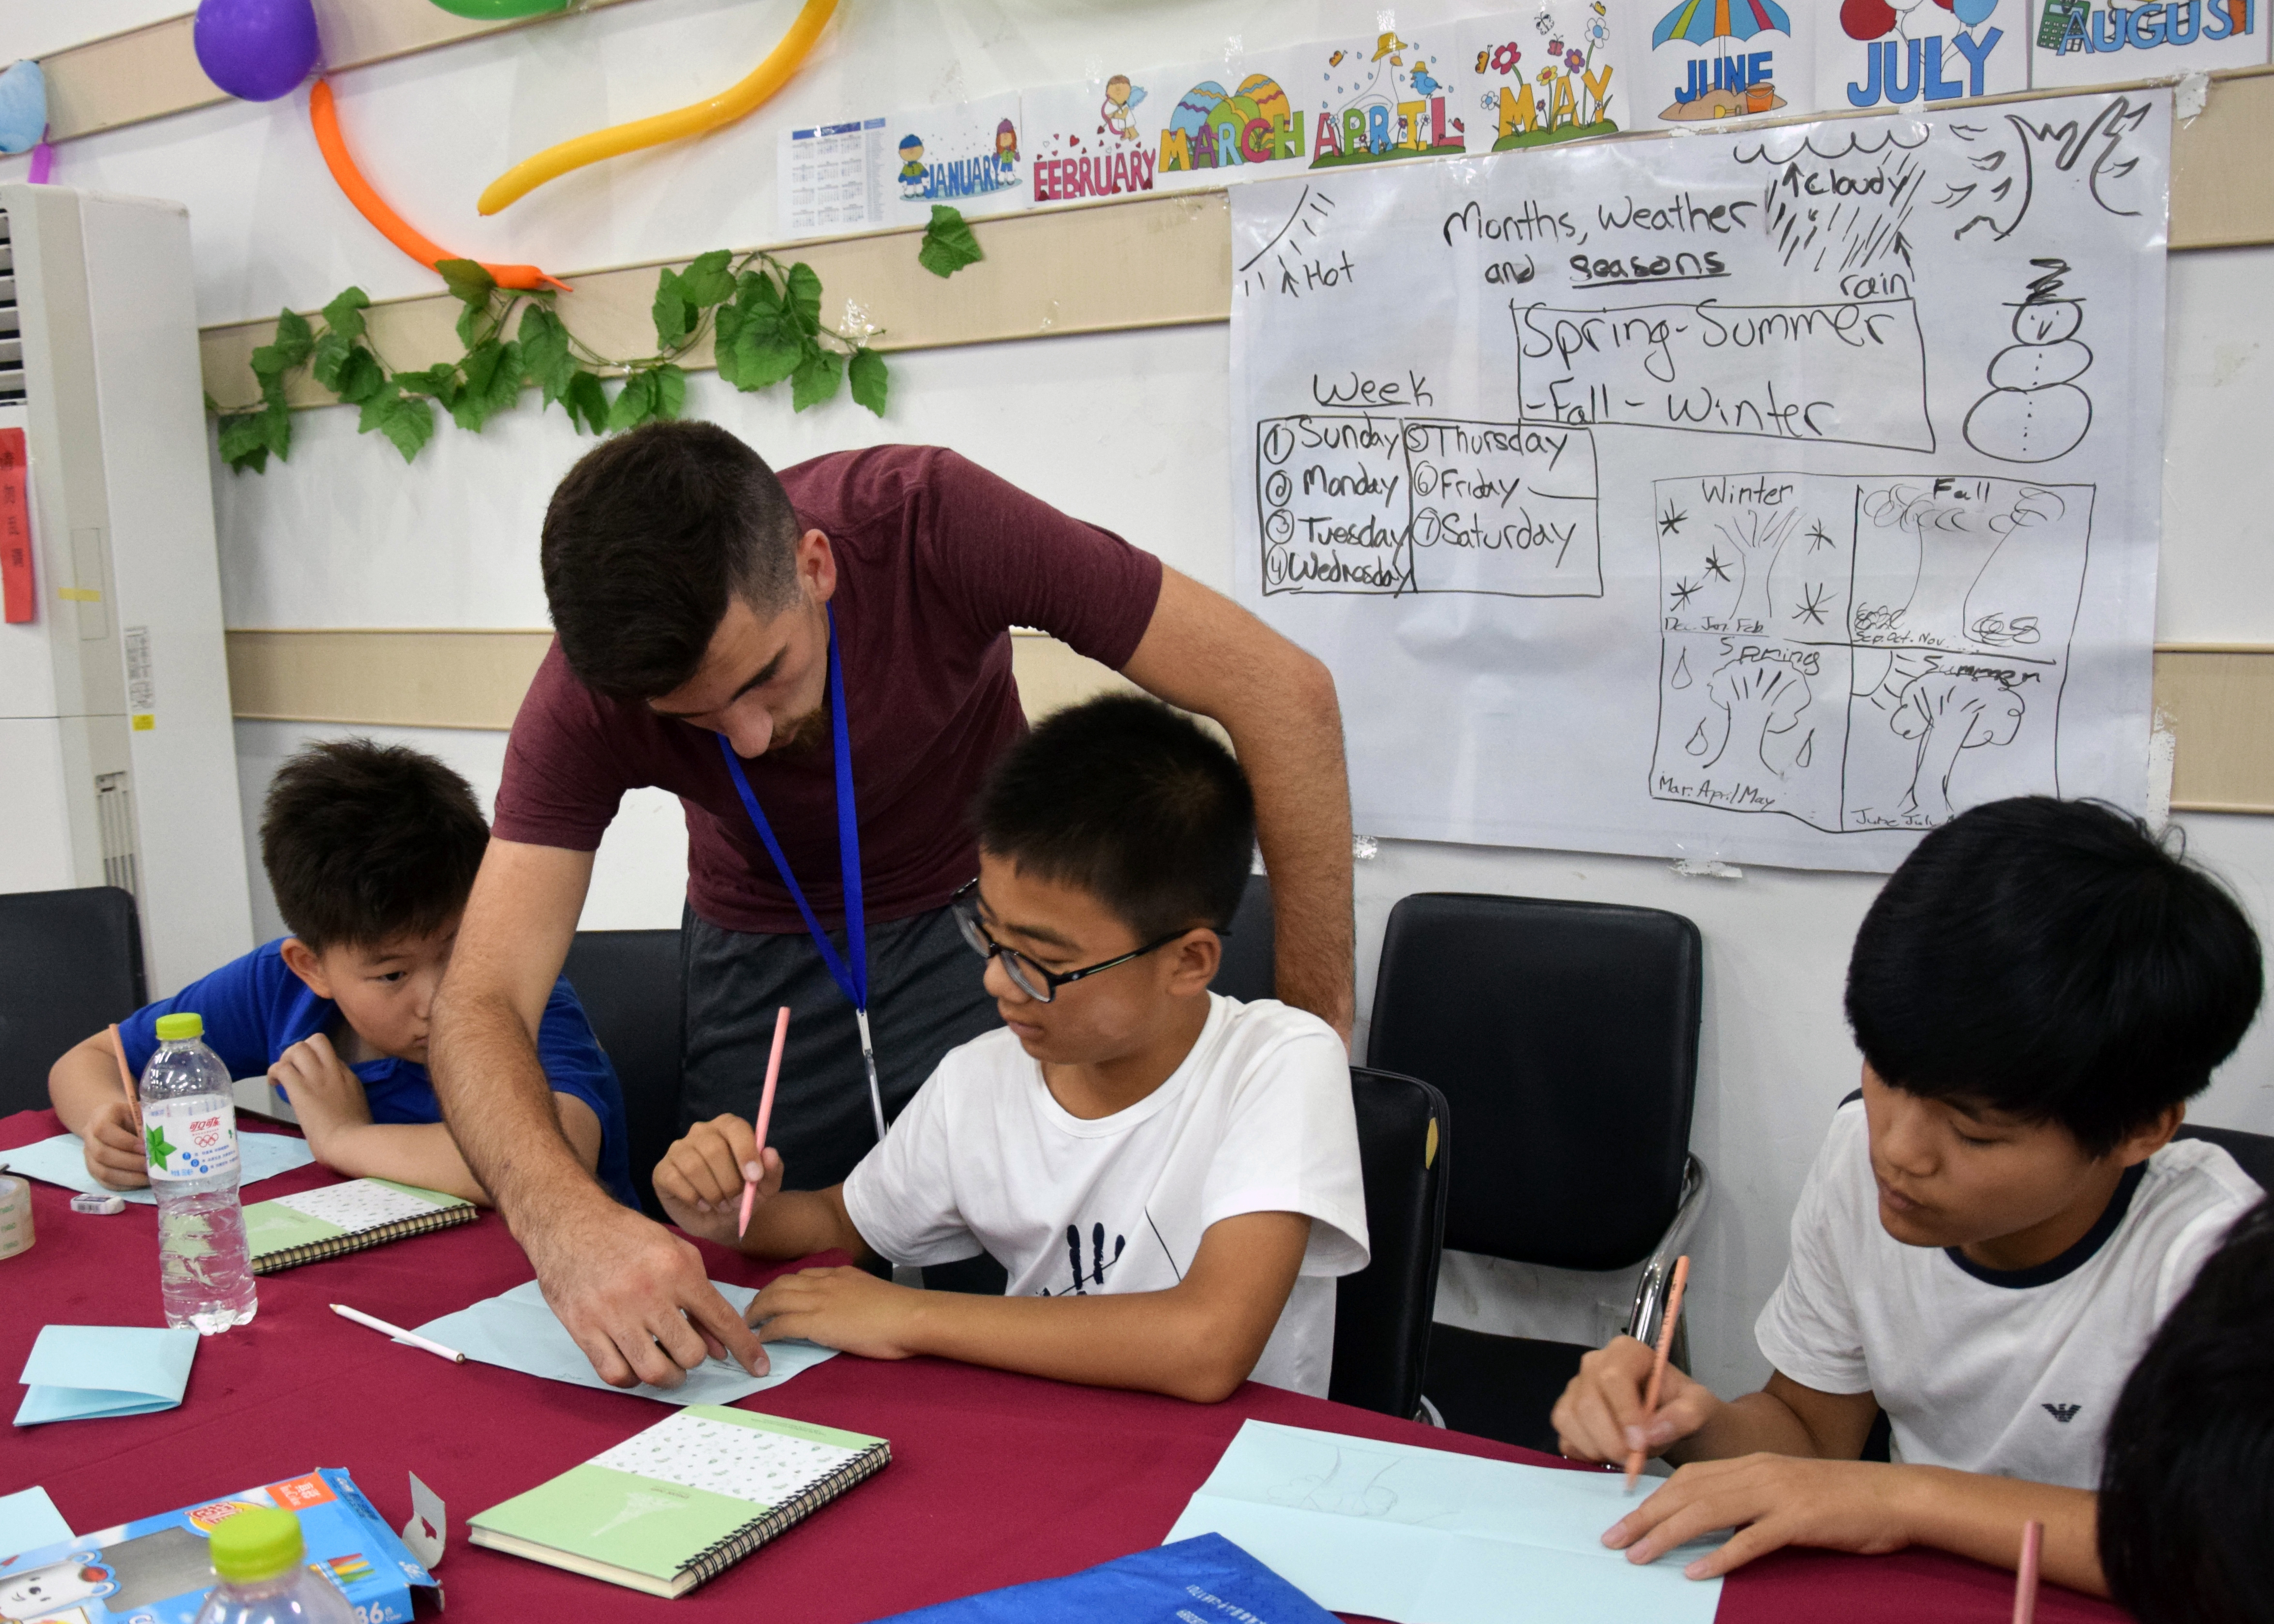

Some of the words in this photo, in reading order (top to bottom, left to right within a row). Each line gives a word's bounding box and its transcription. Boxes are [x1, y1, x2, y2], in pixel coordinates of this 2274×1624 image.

[1674, 50, 1773, 104] JUNE
[1847, 27, 2004, 107] JULY
[1498, 64, 1614, 139] MAY
[1158, 110, 1305, 173] MARCH
[1313, 96, 1464, 163] APRIL
[924, 153, 1002, 199] JANUARY
[1033, 147, 1156, 202] FEBRUARY
[1444, 199, 1588, 247] Months,
[1598, 192, 1757, 234] Weather
[1303, 250, 1355, 291] Hot
[1484, 254, 1535, 284] and
[1840, 272, 1910, 299] rain
[1313, 370, 1434, 407] Week
[1300, 412, 1400, 460] Sunday
[1425, 419, 1568, 471] Thursday
[1303, 462, 1399, 508] Monday
[1441, 468, 1520, 509] Friday
[1702, 476, 1793, 505] Winter
[1933, 477, 1990, 503] Fall
[1298, 514, 1410, 561] Tuesday
[1441, 507, 1576, 568] Saturday
[1289, 550, 1412, 599] Wednesday
